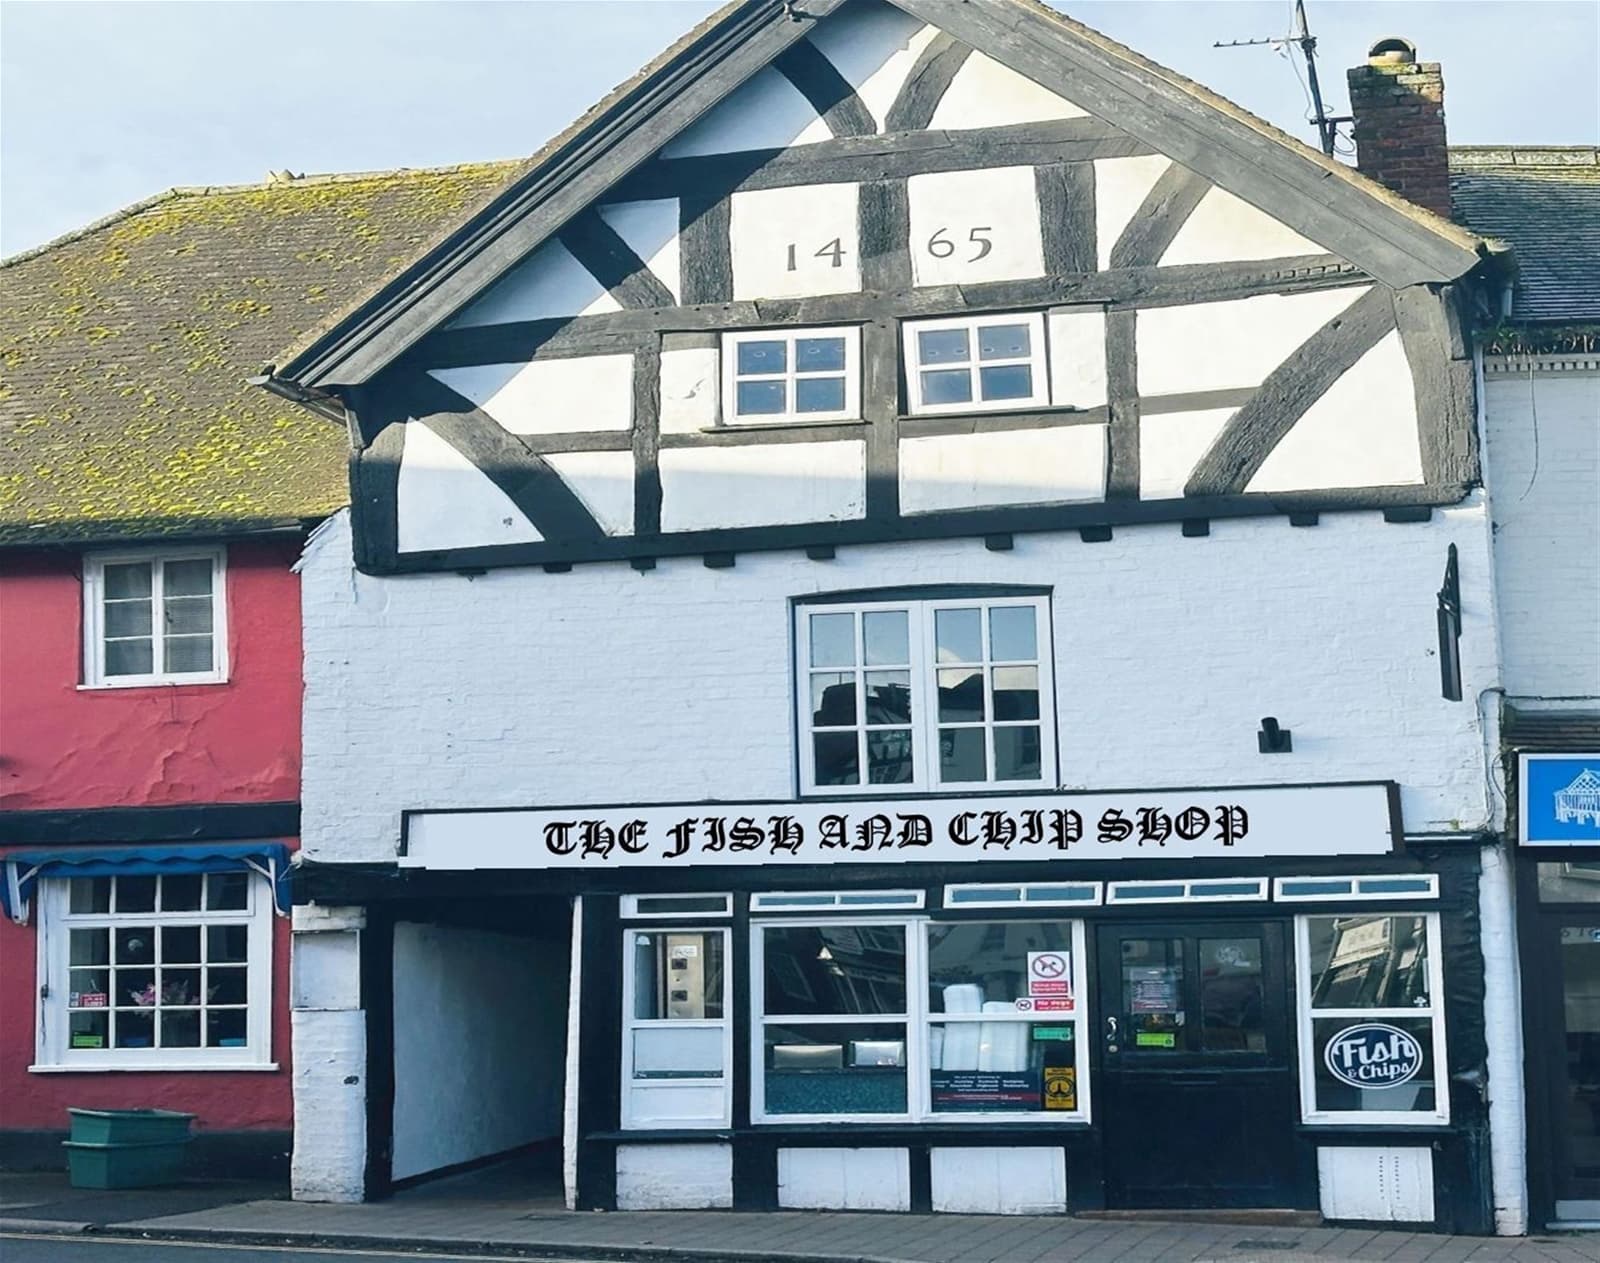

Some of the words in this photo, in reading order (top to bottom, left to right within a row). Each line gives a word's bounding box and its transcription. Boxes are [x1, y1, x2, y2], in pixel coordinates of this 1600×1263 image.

[543, 819, 649, 860] THE
[662, 815, 805, 859] FISH
[818, 813, 934, 852] AND
[949, 808, 1083, 850] CHIP
[1097, 804, 1249, 847] SHOP
[1332, 1034, 1416, 1068] Fish
[1358, 1062, 1410, 1080] Chips
